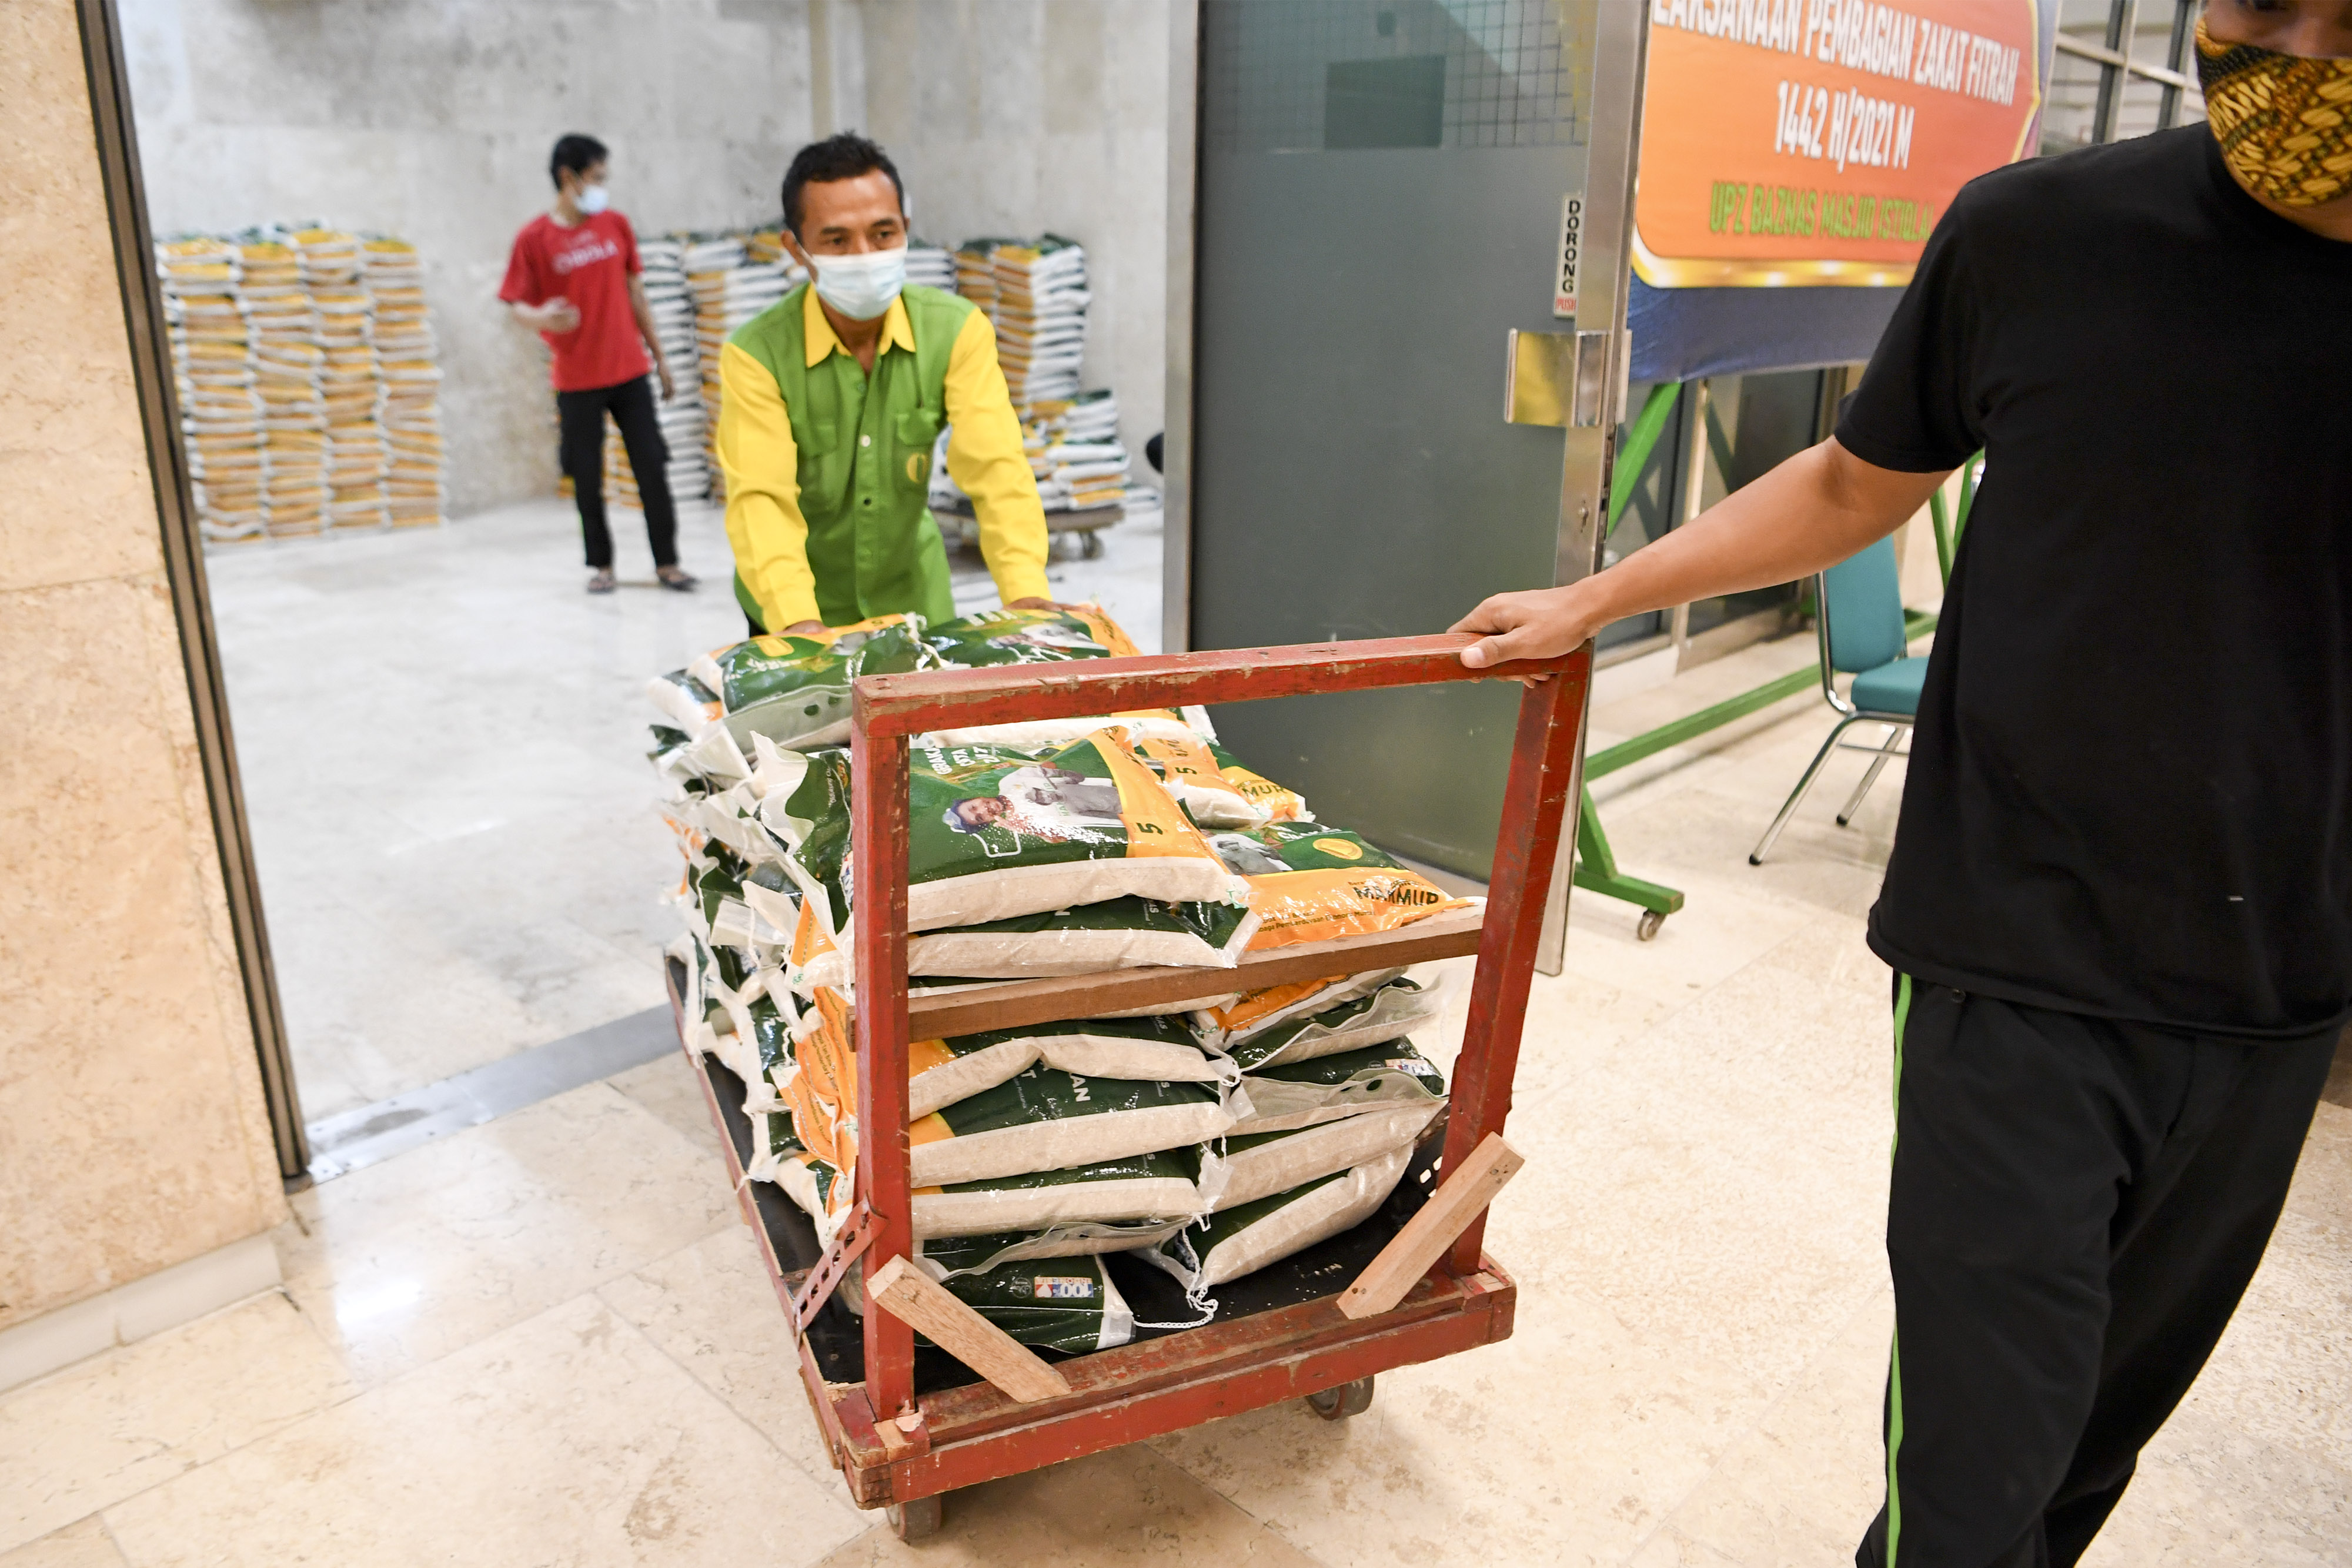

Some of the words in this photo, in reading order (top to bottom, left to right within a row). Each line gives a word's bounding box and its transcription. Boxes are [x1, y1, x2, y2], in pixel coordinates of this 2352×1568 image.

[1803, 0, 1916, 81] PEMBAGIAN
[1913, 18, 1970, 94] ZAKAT
[1965, 34, 2020, 107] FITRAH
[1774, 79, 1828, 159] 1442
[1828, 86, 1896, 174] H/2021
[1893, 104, 1915, 170] M
[1709, 180, 1748, 233] UPZ
[1750, 185, 1818, 236] BAZNAS
[1820, 191, 1876, 239] MASJID
[1562, 199, 1581, 293] DORONG
[1555, 296, 1576, 312] PUSH
[1174, 767, 1198, 775] 5
[1135, 822, 1164, 835] 5
